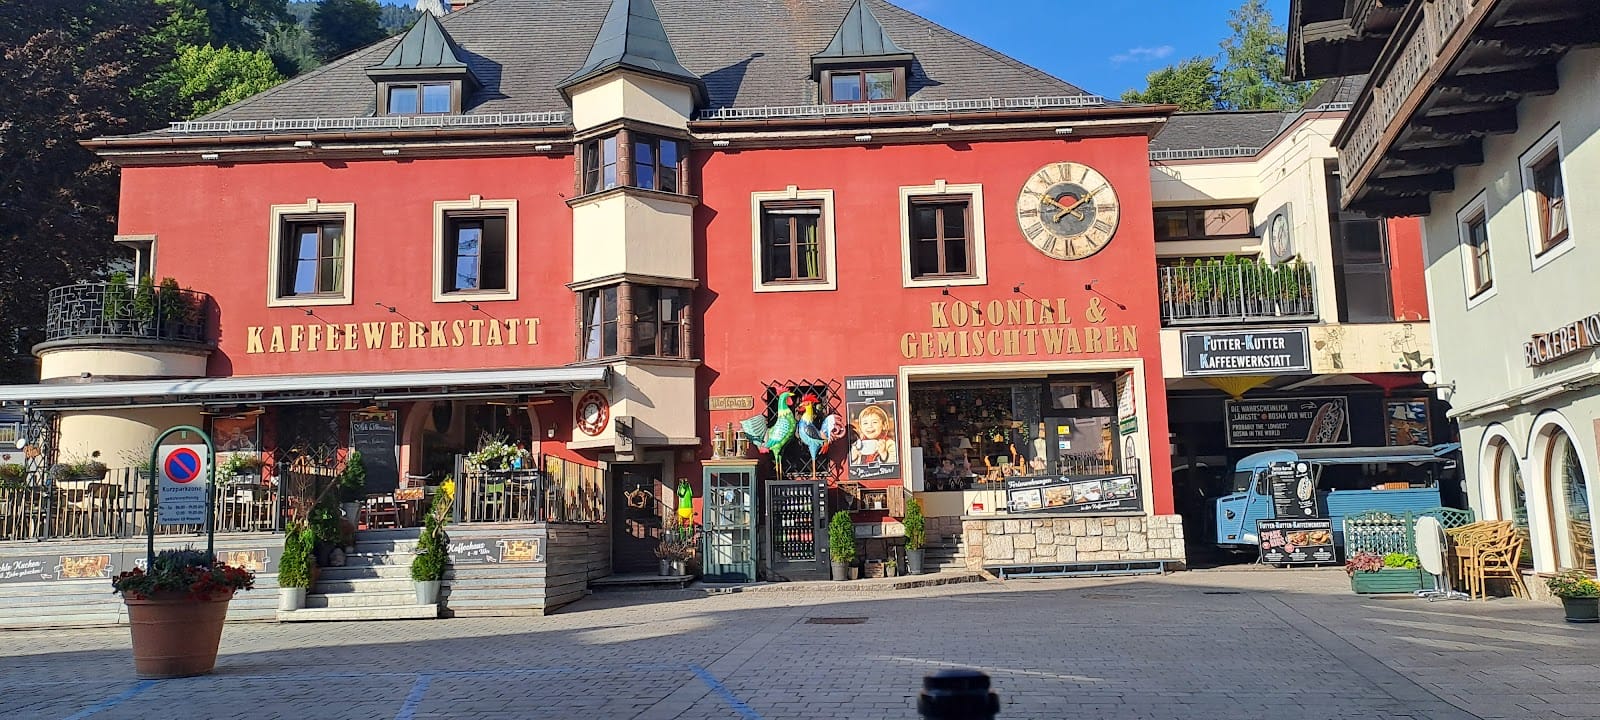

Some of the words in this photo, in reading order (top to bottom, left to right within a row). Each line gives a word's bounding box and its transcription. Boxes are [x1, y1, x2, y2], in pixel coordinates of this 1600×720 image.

[930, 297, 1072, 329] KOLONIAL
[1085, 296, 1107, 324] &
[246, 317, 541, 354] KAFFEEWERKSTATT
[900, 324, 1140, 360] GEMISCHTWAREN
[1199, 353, 1291, 369] KAFFEEWERKSTATT
[1230, 405, 1240, 413] DIE
[1241, 404, 1289, 412] WAHRSCHEINLICH
[1268, 412, 1286, 420] BOSNA
[1299, 411, 1313, 419] WELT
